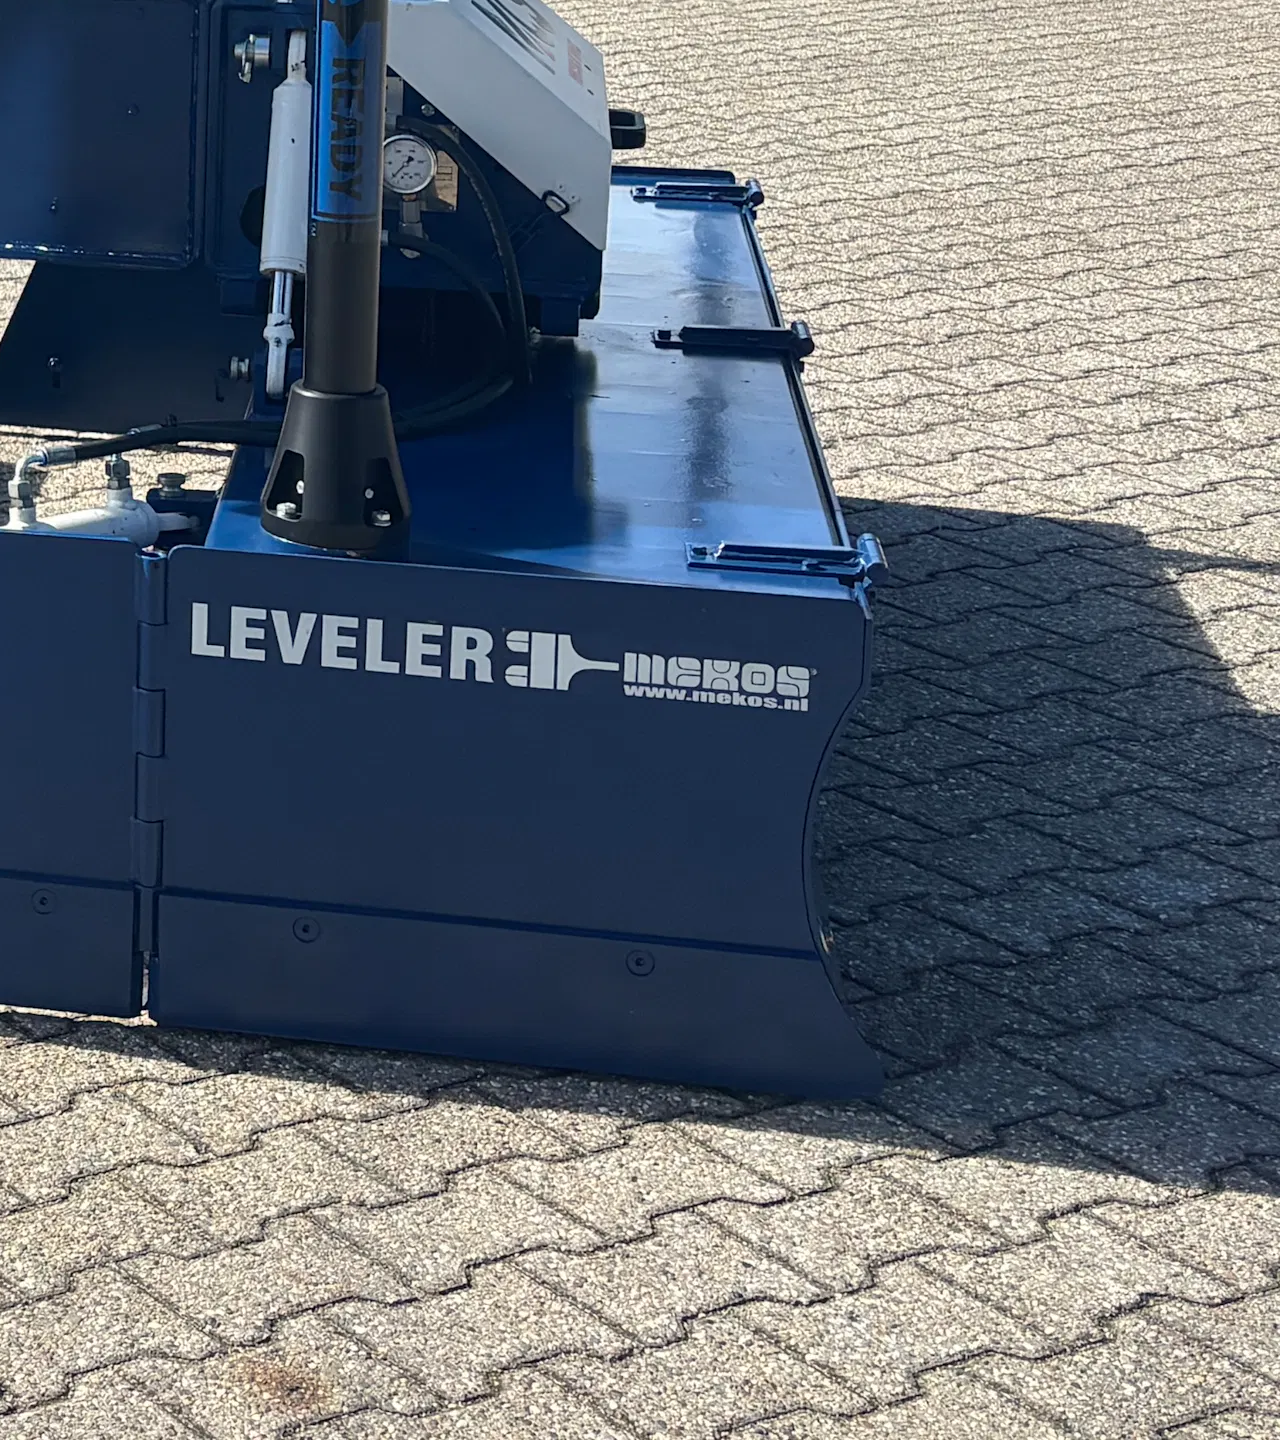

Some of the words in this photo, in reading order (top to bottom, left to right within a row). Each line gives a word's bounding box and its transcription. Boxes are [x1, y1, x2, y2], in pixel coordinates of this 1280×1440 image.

[329, 57, 365, 202] READY
[191, 601, 495, 684] LEVELER
[623, 684, 809, 712] www.mekos.nl
